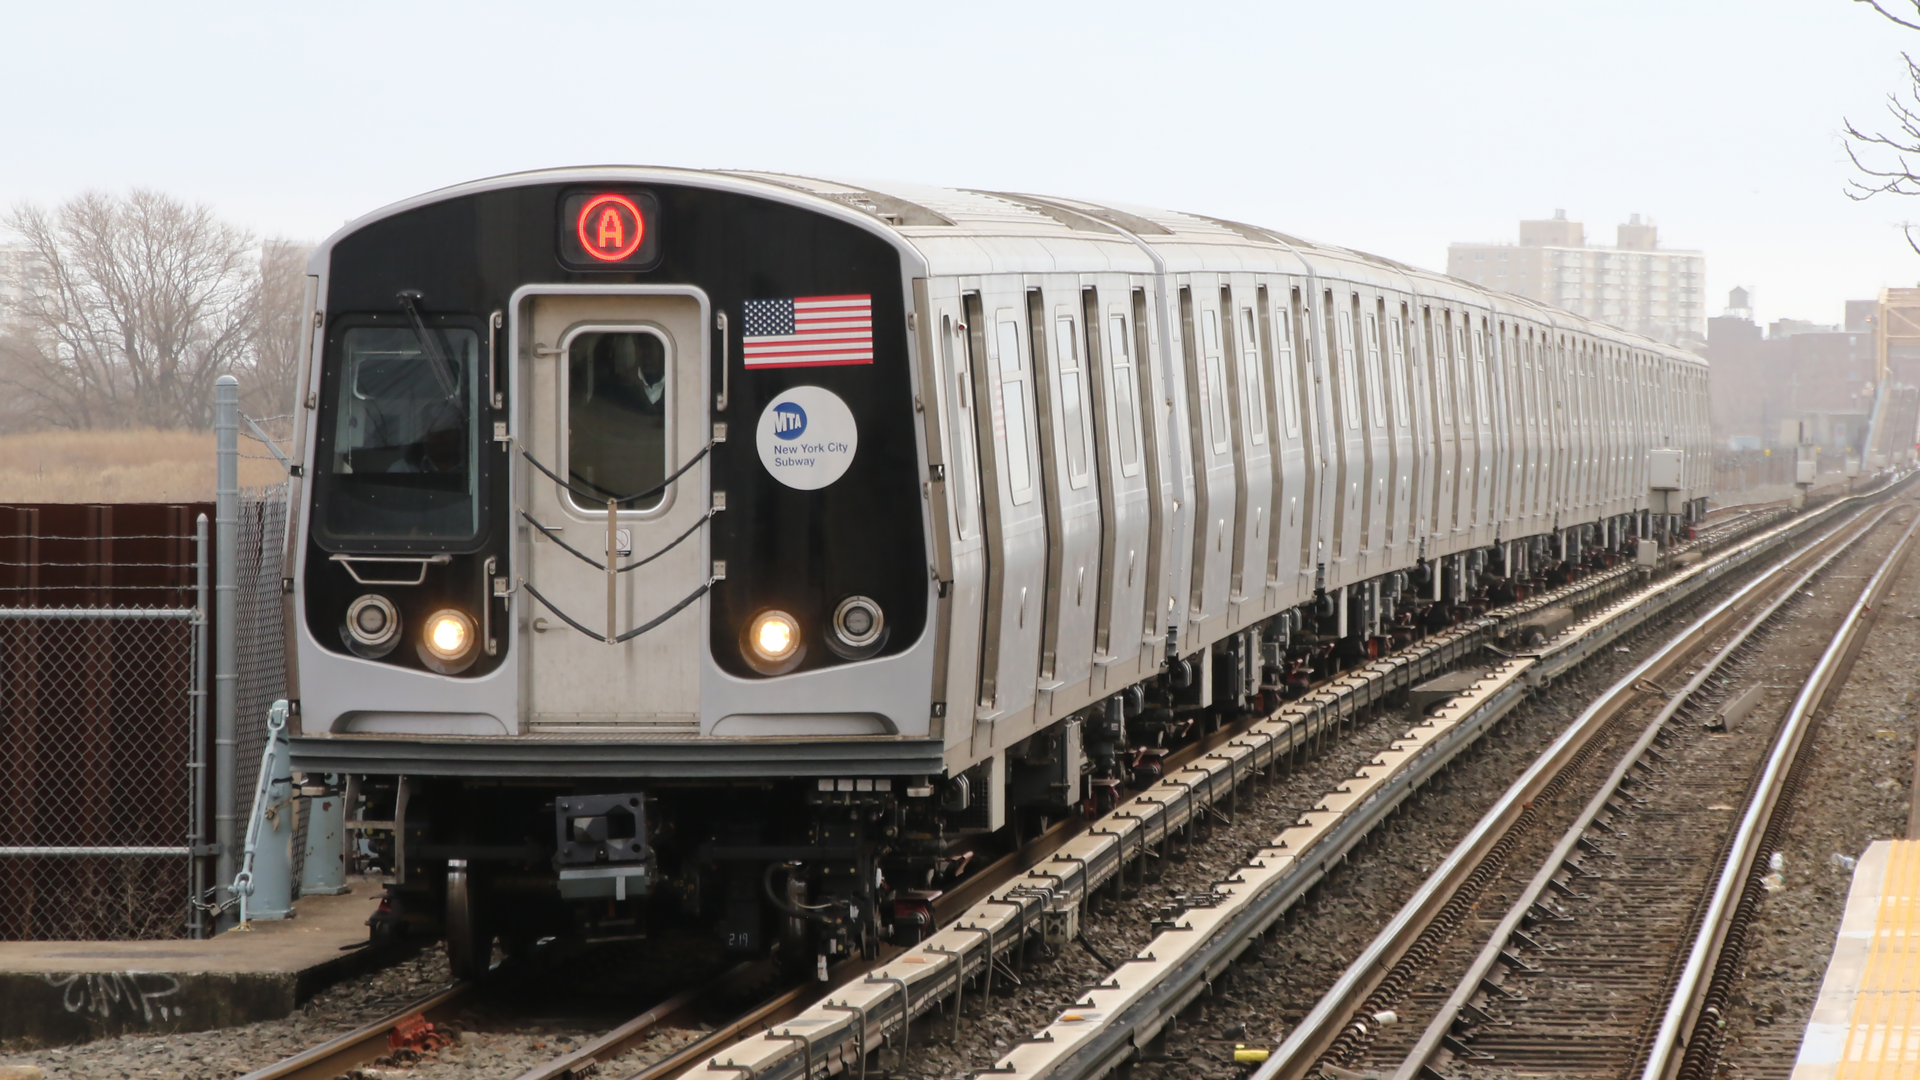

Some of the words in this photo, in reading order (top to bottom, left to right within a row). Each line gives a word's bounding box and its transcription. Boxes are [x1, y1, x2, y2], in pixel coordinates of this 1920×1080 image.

[599, 208, 623, 248] A
[772, 410, 802, 434] MTA
[774, 445, 798, 454] New
[801, 444, 825, 453] York
[828, 442, 848, 453] City
[775, 457, 815, 467] Subway
[729, 933, 748, 946] 219
